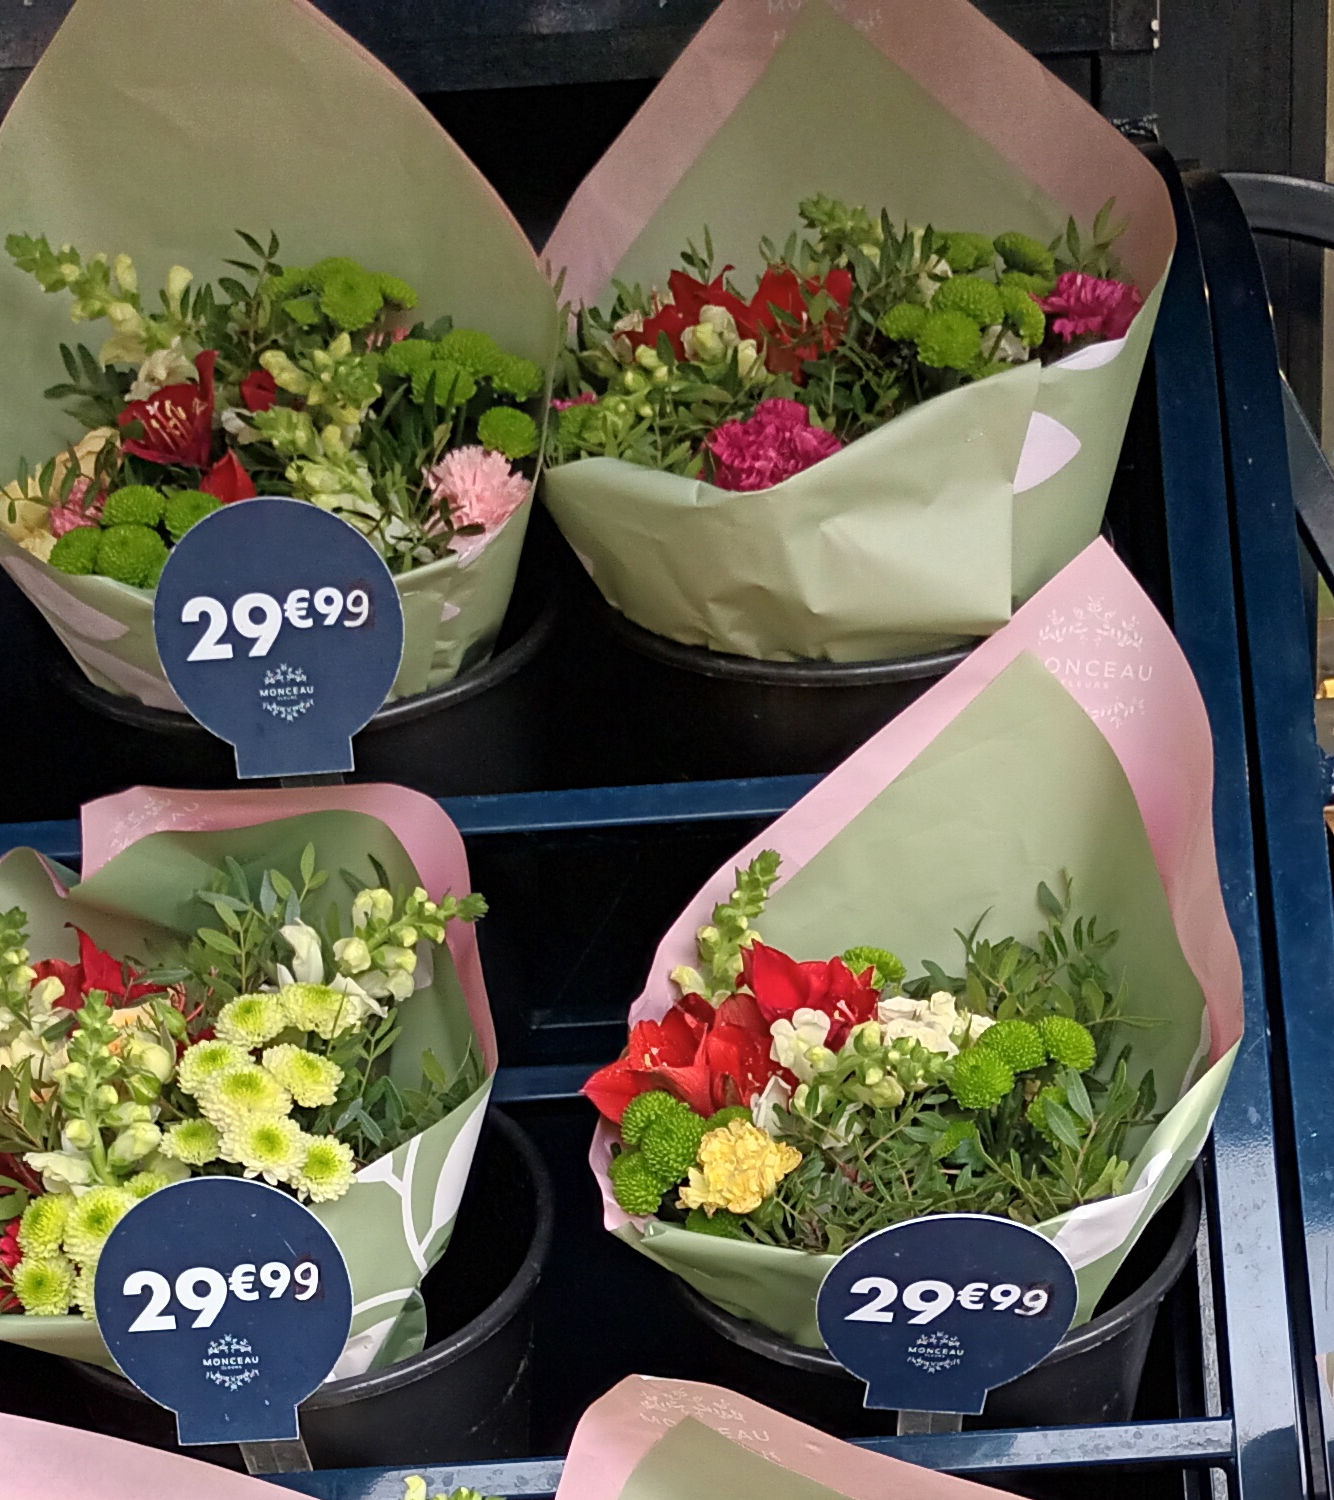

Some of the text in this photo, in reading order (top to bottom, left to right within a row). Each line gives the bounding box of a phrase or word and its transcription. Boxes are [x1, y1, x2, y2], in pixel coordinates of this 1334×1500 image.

[180, 586, 370, 662] 29€99
[1044, 656, 1153, 682] ONCEAU
[259, 686, 315, 697] MONCEAU
[122, 1260, 319, 1333] 29€99
[843, 1276, 1049, 1325] 29€99
[202, 1355, 260, 1367] MONCEAU
[907, 1346, 965, 1357] MONCEAU
[639, 1412, 770, 1442] MOEAU
